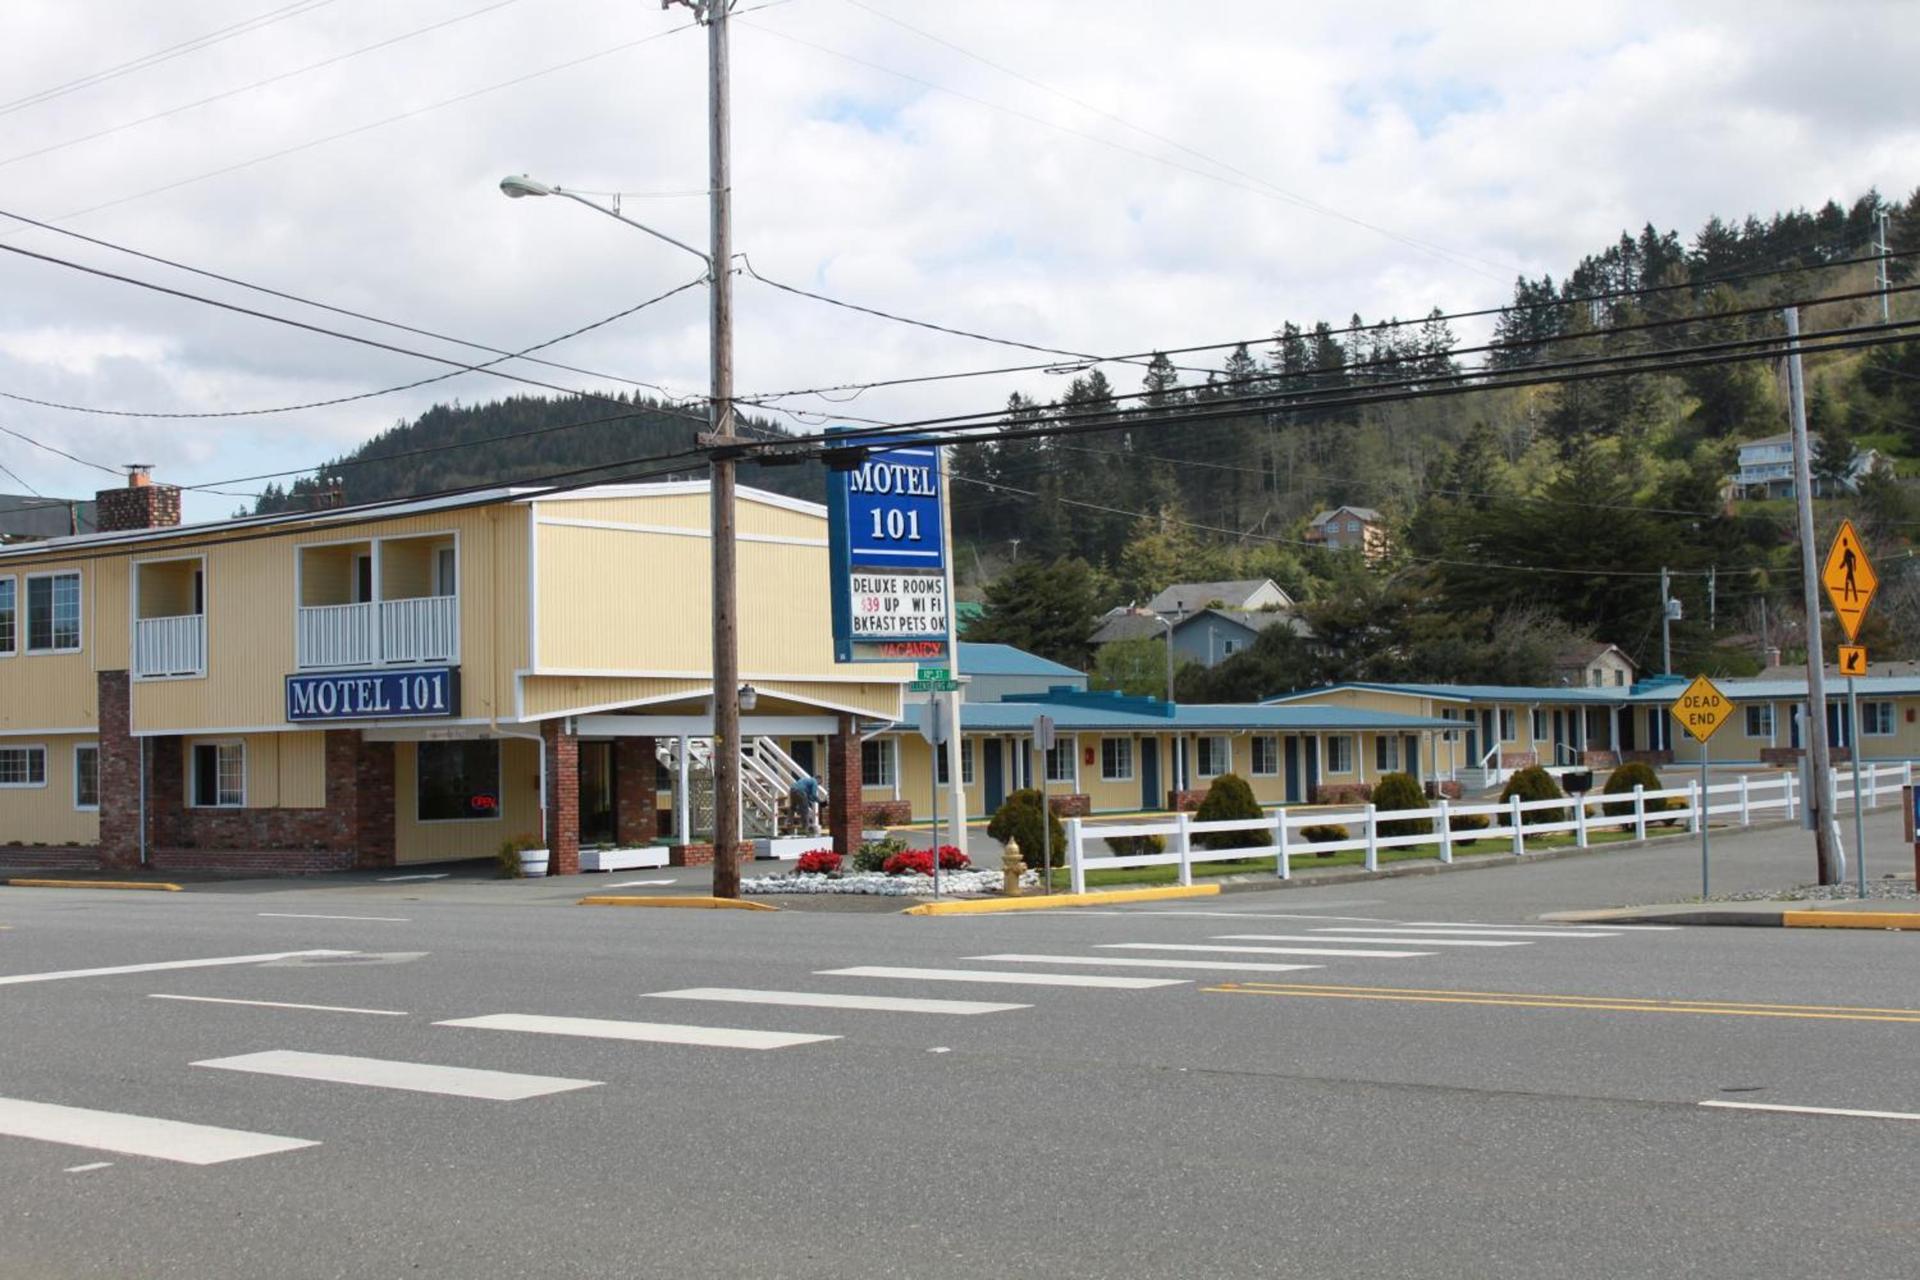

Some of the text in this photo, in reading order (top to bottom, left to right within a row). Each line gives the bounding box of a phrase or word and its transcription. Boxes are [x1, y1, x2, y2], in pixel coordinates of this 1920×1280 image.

[850, 462, 936, 496] MOTEL
[870, 507, 921, 540] 101
[853, 578, 942, 594] DELUXE ROOMS
[884, 597, 900, 612] UP
[853, 616, 945, 631] BKFAST PETS OK
[881, 641, 943, 658] VACANCY
[292, 674, 445, 715] MOTEL 101
[1683, 695, 1720, 708] DEAD
[1689, 712, 1715, 726] END
